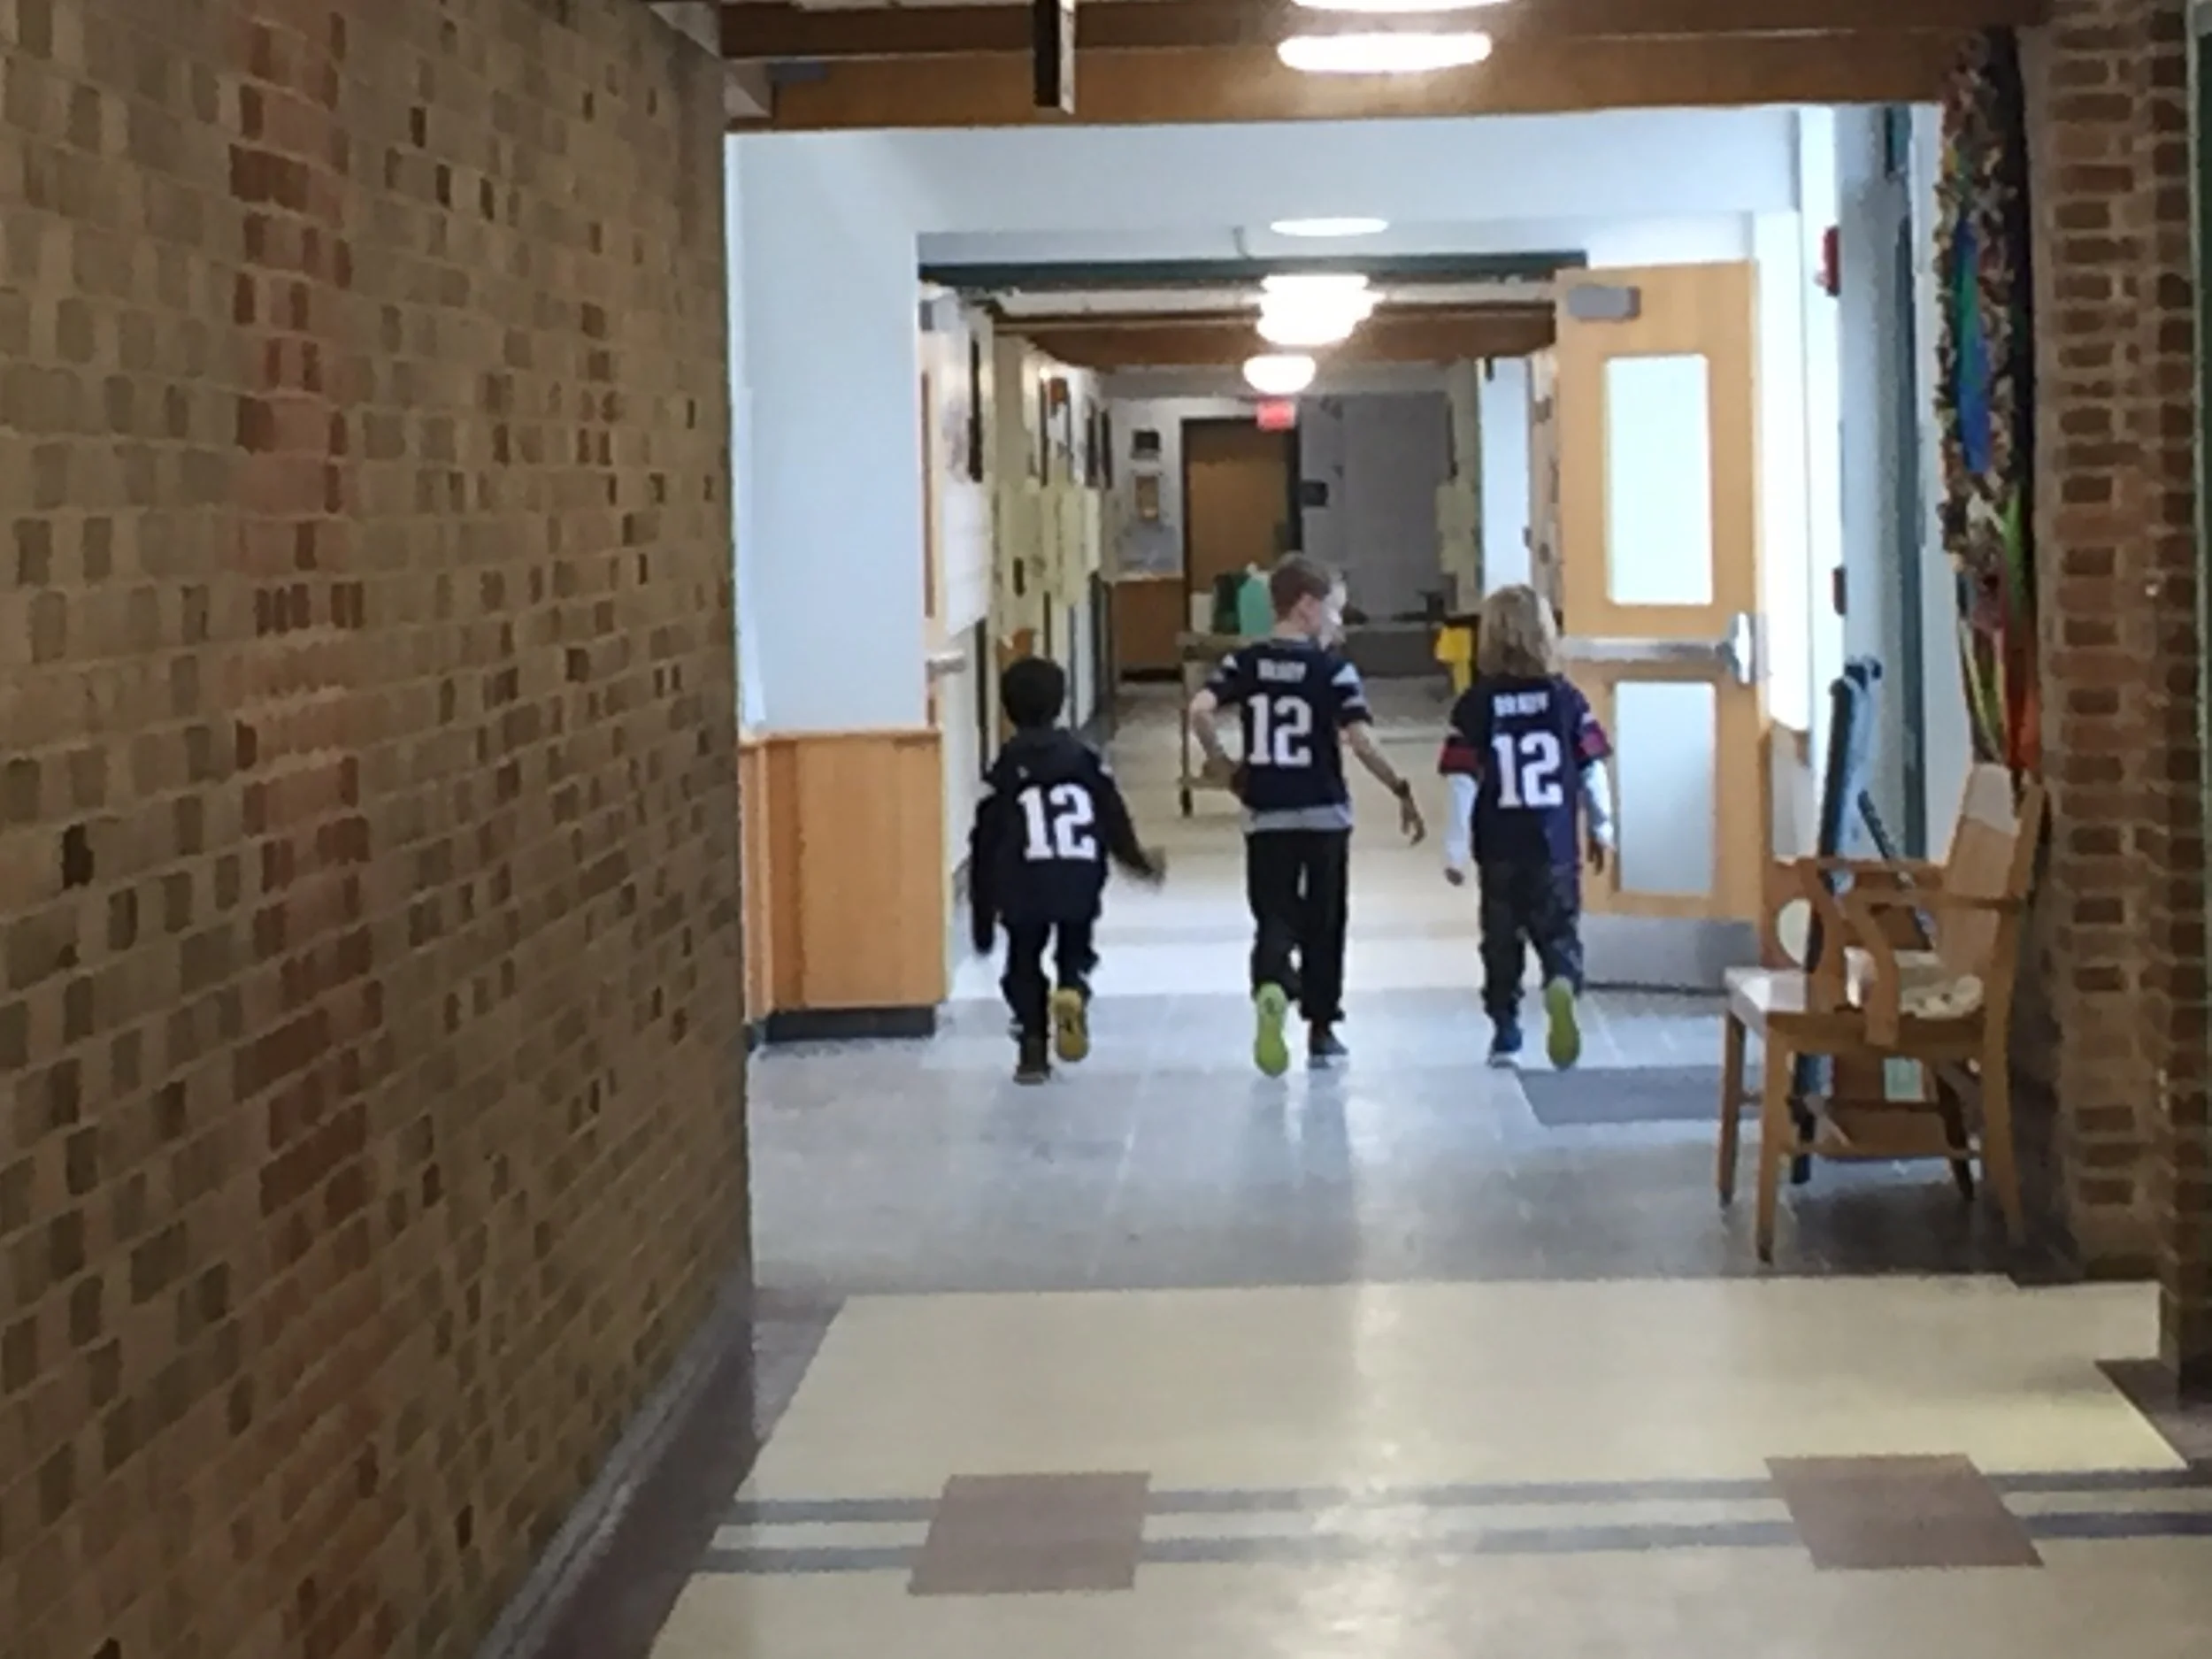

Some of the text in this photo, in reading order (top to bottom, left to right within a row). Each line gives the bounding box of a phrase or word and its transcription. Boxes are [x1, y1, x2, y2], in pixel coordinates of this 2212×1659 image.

[1249, 695, 1312, 765] 12
[1493, 733, 1563, 807] 12
[1018, 785, 1096, 860] 12
